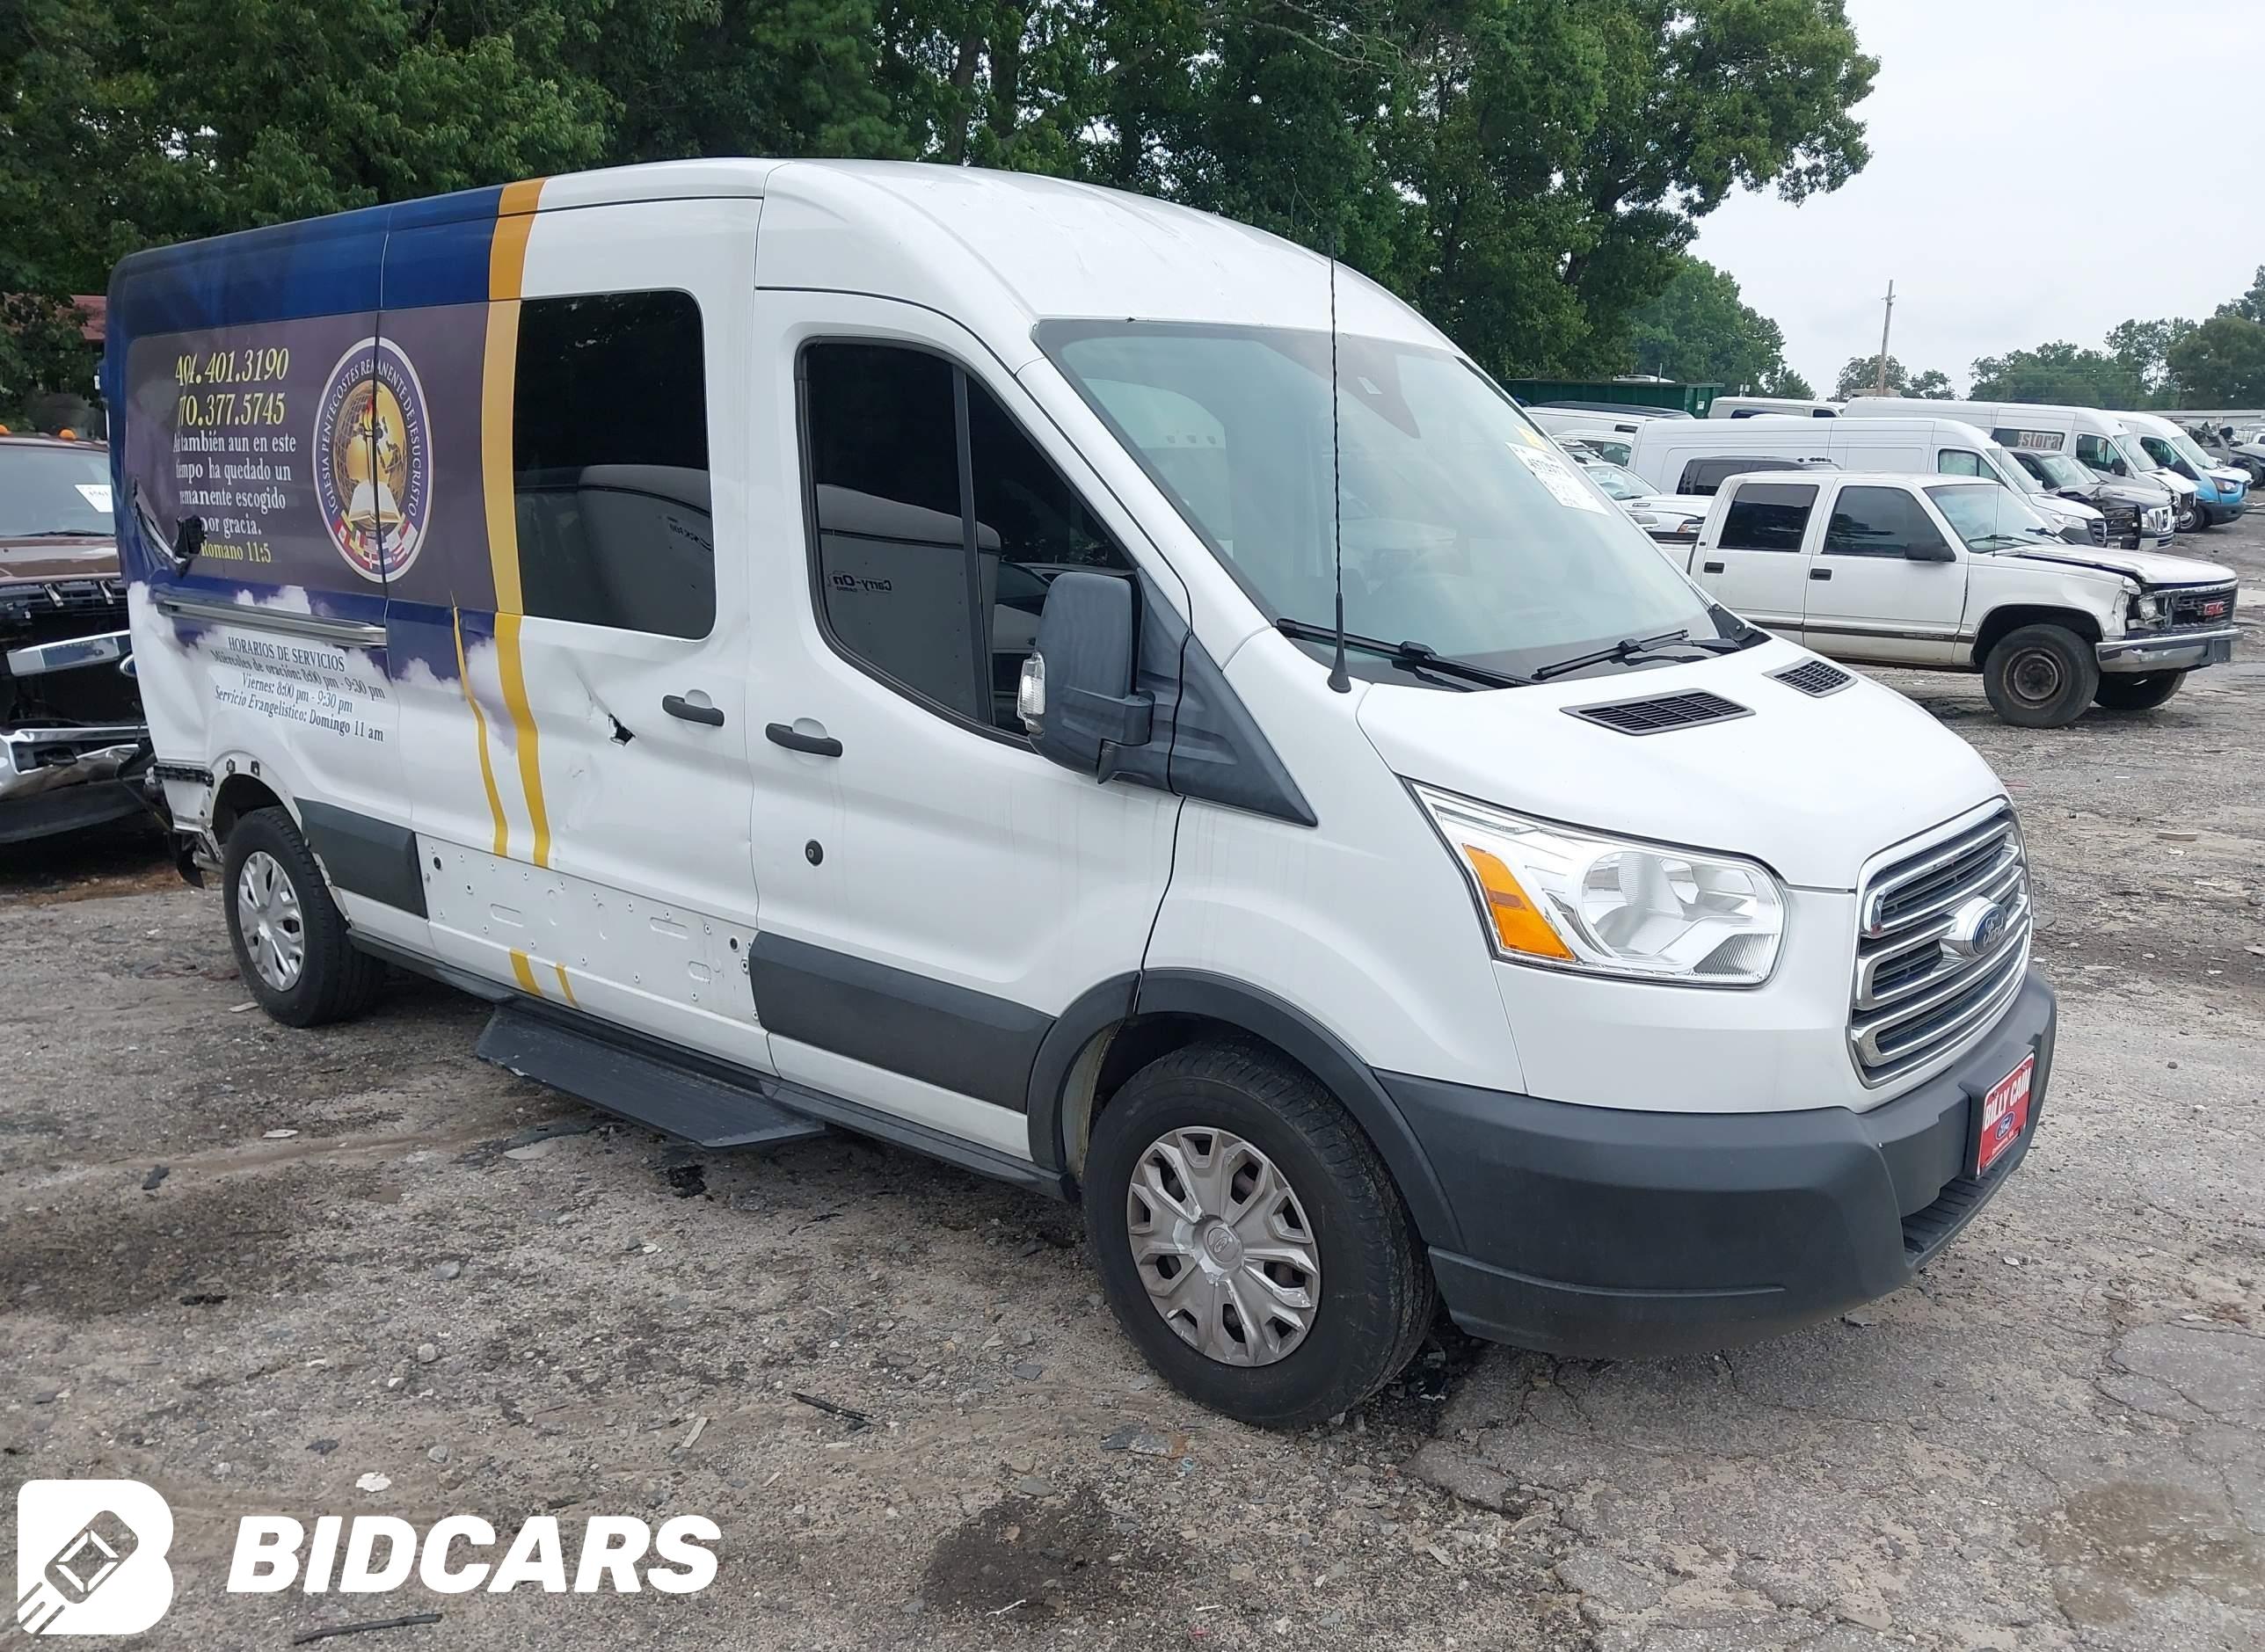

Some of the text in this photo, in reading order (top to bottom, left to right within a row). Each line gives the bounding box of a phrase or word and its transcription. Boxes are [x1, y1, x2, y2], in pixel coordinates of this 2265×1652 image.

[322, 365, 360, 451] PENTECOSTES
[404, 396, 415, 420] DE
[229, 436, 250, 452] aun
[253, 436, 268, 452] en
[272, 433, 296, 453] este
[208, 457, 221, 479] ha
[224, 457, 271, 485] quedado
[274, 464, 292, 481] un
[322, 456, 339, 514] IGLESIA
[408, 420, 422, 517] JESUCRISTO
[236, 486, 287, 514] escogido
[222, 513, 262, 539] gracia.
[246, 541, 272, 564] 11:5
[228, 636, 345, 673] HORARIOS DE SERVICIOS
[242, 672, 275, 694] Viernes:
[276, 681, 295, 699] 8:00
[295, 688, 310, 703] pm
[317, 689, 337, 709] 9:30
[338, 698, 353, 715] pm
[252, 658, 265, 673] de
[323, 675, 339, 691] pm
[344, 676, 368, 695] 9:30
[368, 685, 386, 701] pm
[215, 685, 246, 706] Servicio
[309, 709, 351, 737] Domingo
[354, 720, 365, 737] 11
[368, 727, 384, 742] am
[1984, 1086, 2010, 1132] BILLY
